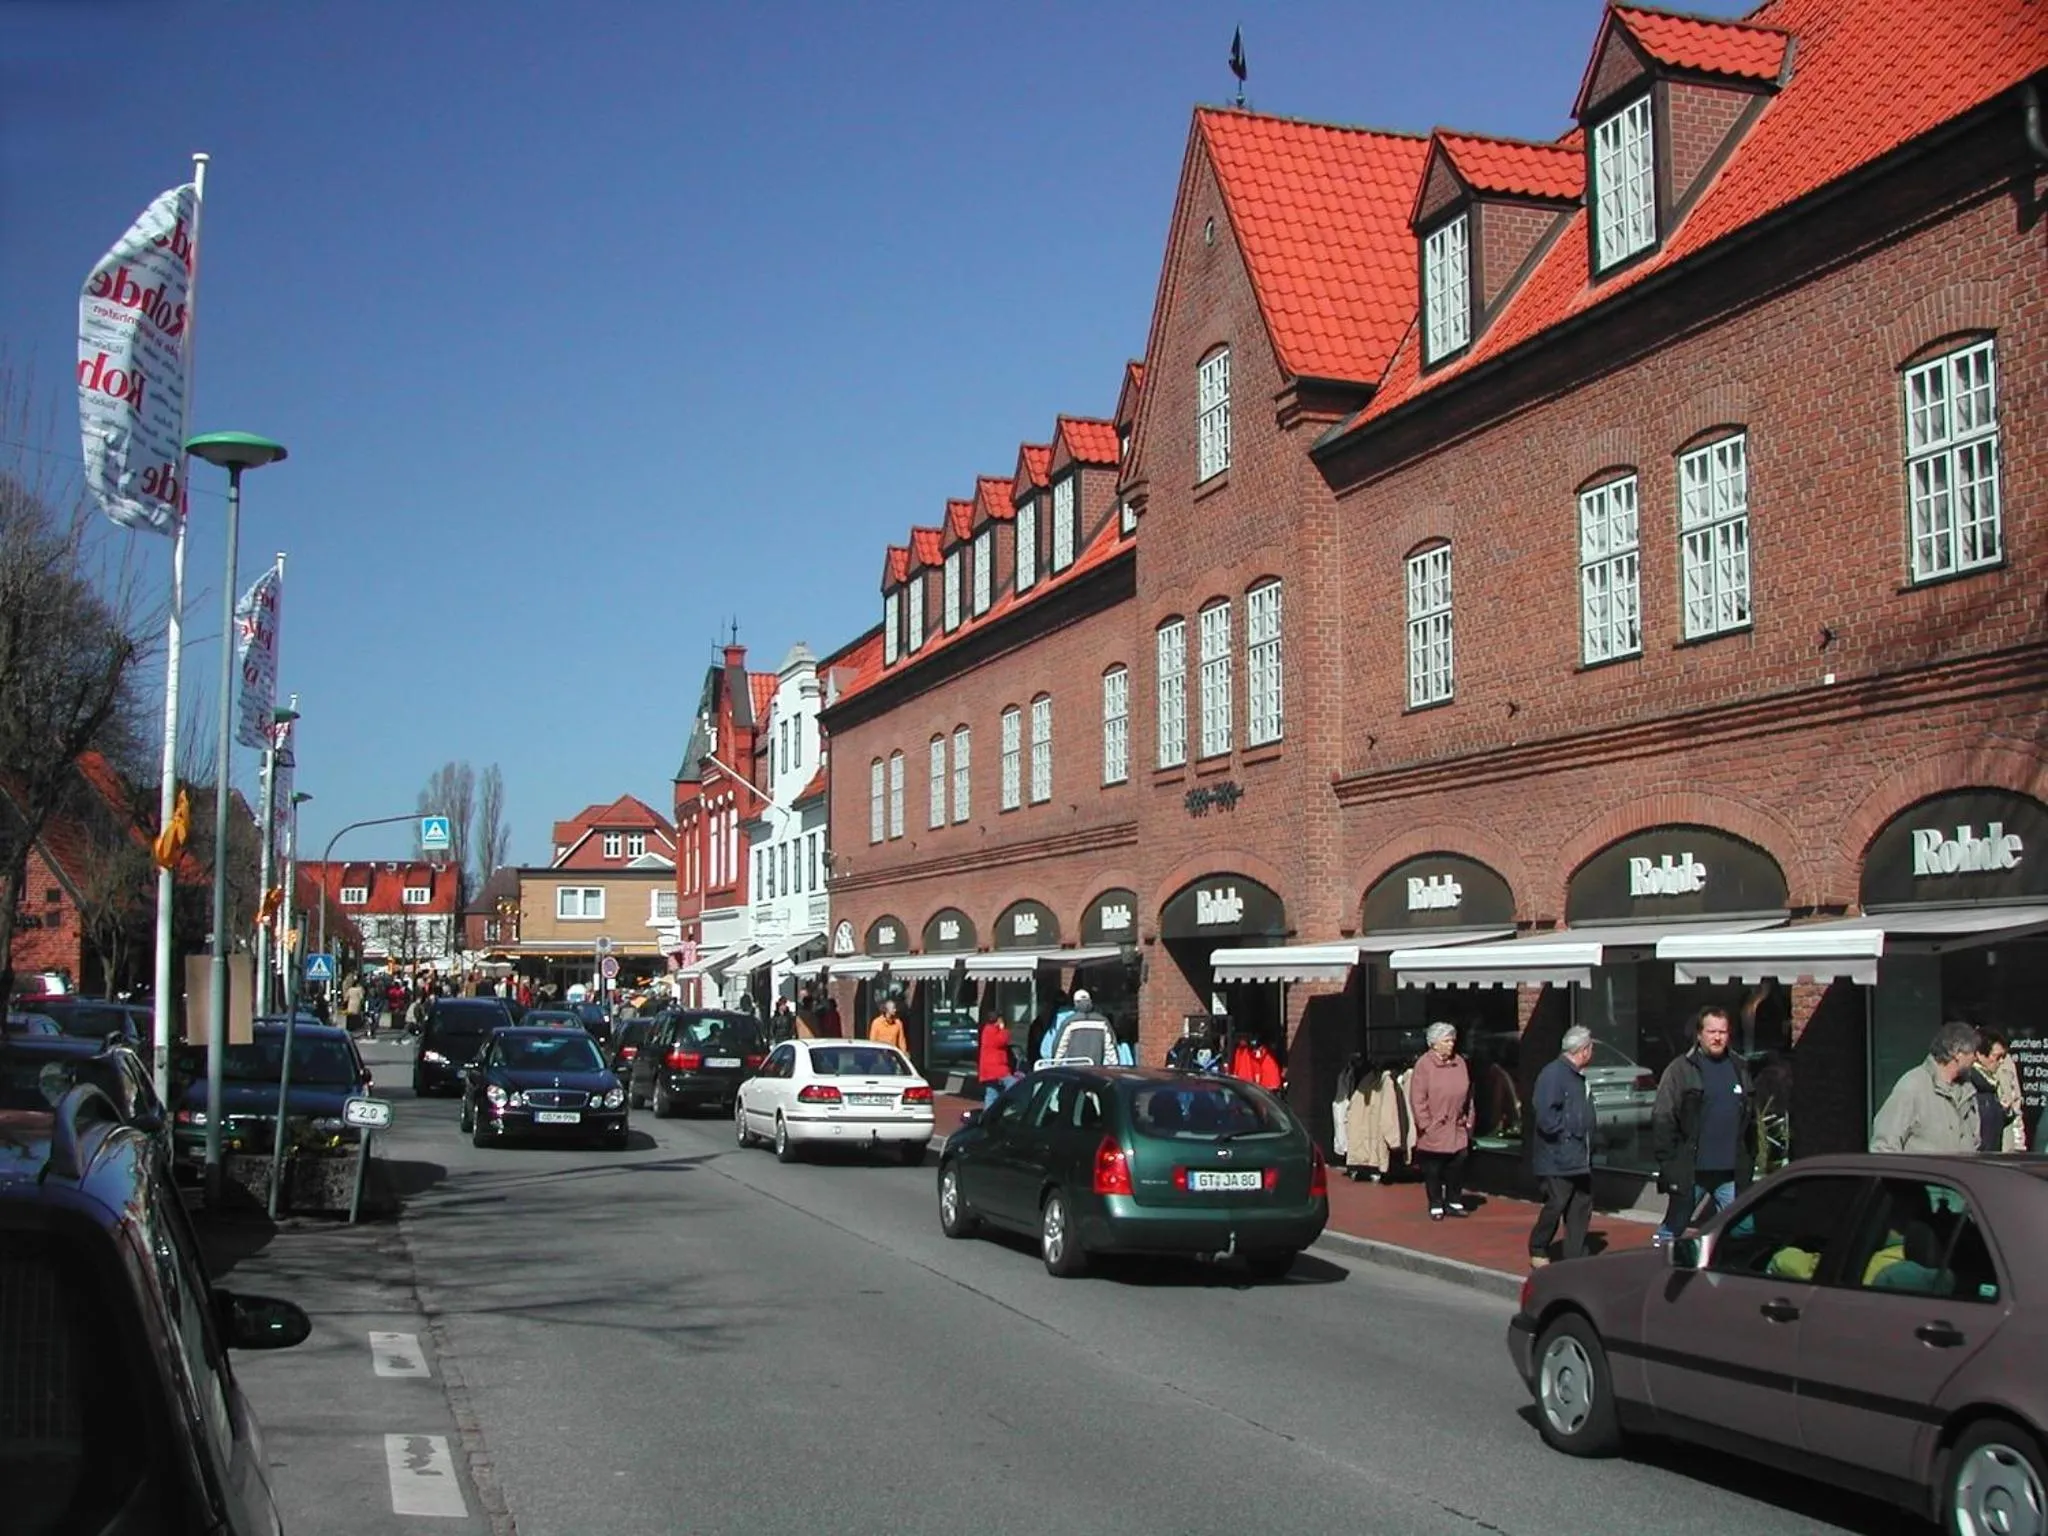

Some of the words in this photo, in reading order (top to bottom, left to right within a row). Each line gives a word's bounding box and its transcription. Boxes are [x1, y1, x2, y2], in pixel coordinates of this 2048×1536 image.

[1912, 822, 2023, 876] Rohde
[1407, 874, 1463, 910] Rohde
[1629, 852, 1707, 896] Rohde
[1199, 1175, 1217, 1187] GT
